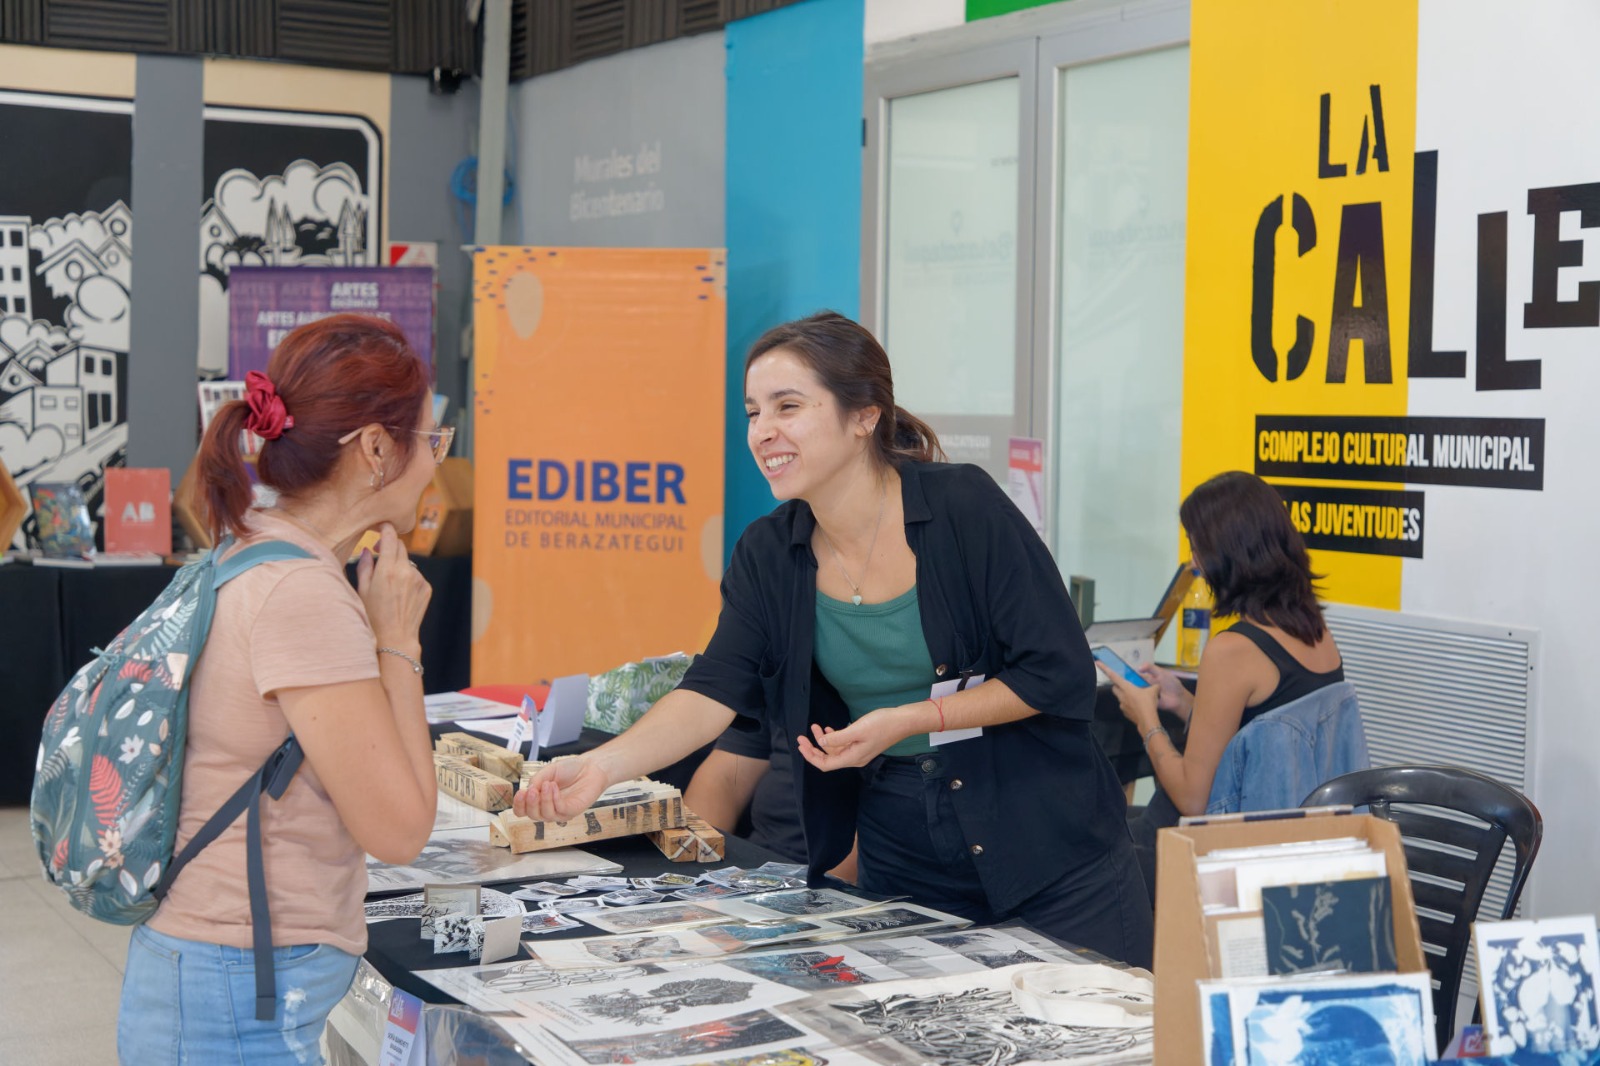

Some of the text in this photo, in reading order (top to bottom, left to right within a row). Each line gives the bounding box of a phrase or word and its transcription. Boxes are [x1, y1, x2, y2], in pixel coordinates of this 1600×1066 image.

[1318, 84, 1390, 179] LA
[574, 139, 661, 183] Murales del
[569, 181, 665, 222] Bicentenario
[330, 282, 379, 297] ARTES
[1251, 149, 1600, 392] CALLE
[256, 311, 295, 326] ARTES
[1258, 430, 1535, 472] COMPLEJO CULTURAL MUNICIPAL
[507, 458, 687, 504] EDIBER
[121, 502, 156, 523] AB
[504, 508, 687, 531] EDITORIAL MUNICIPAL
[1283, 501, 1421, 541] AS JUVENTUDES
[505, 530, 684, 553] DE BERAZATEGUI
